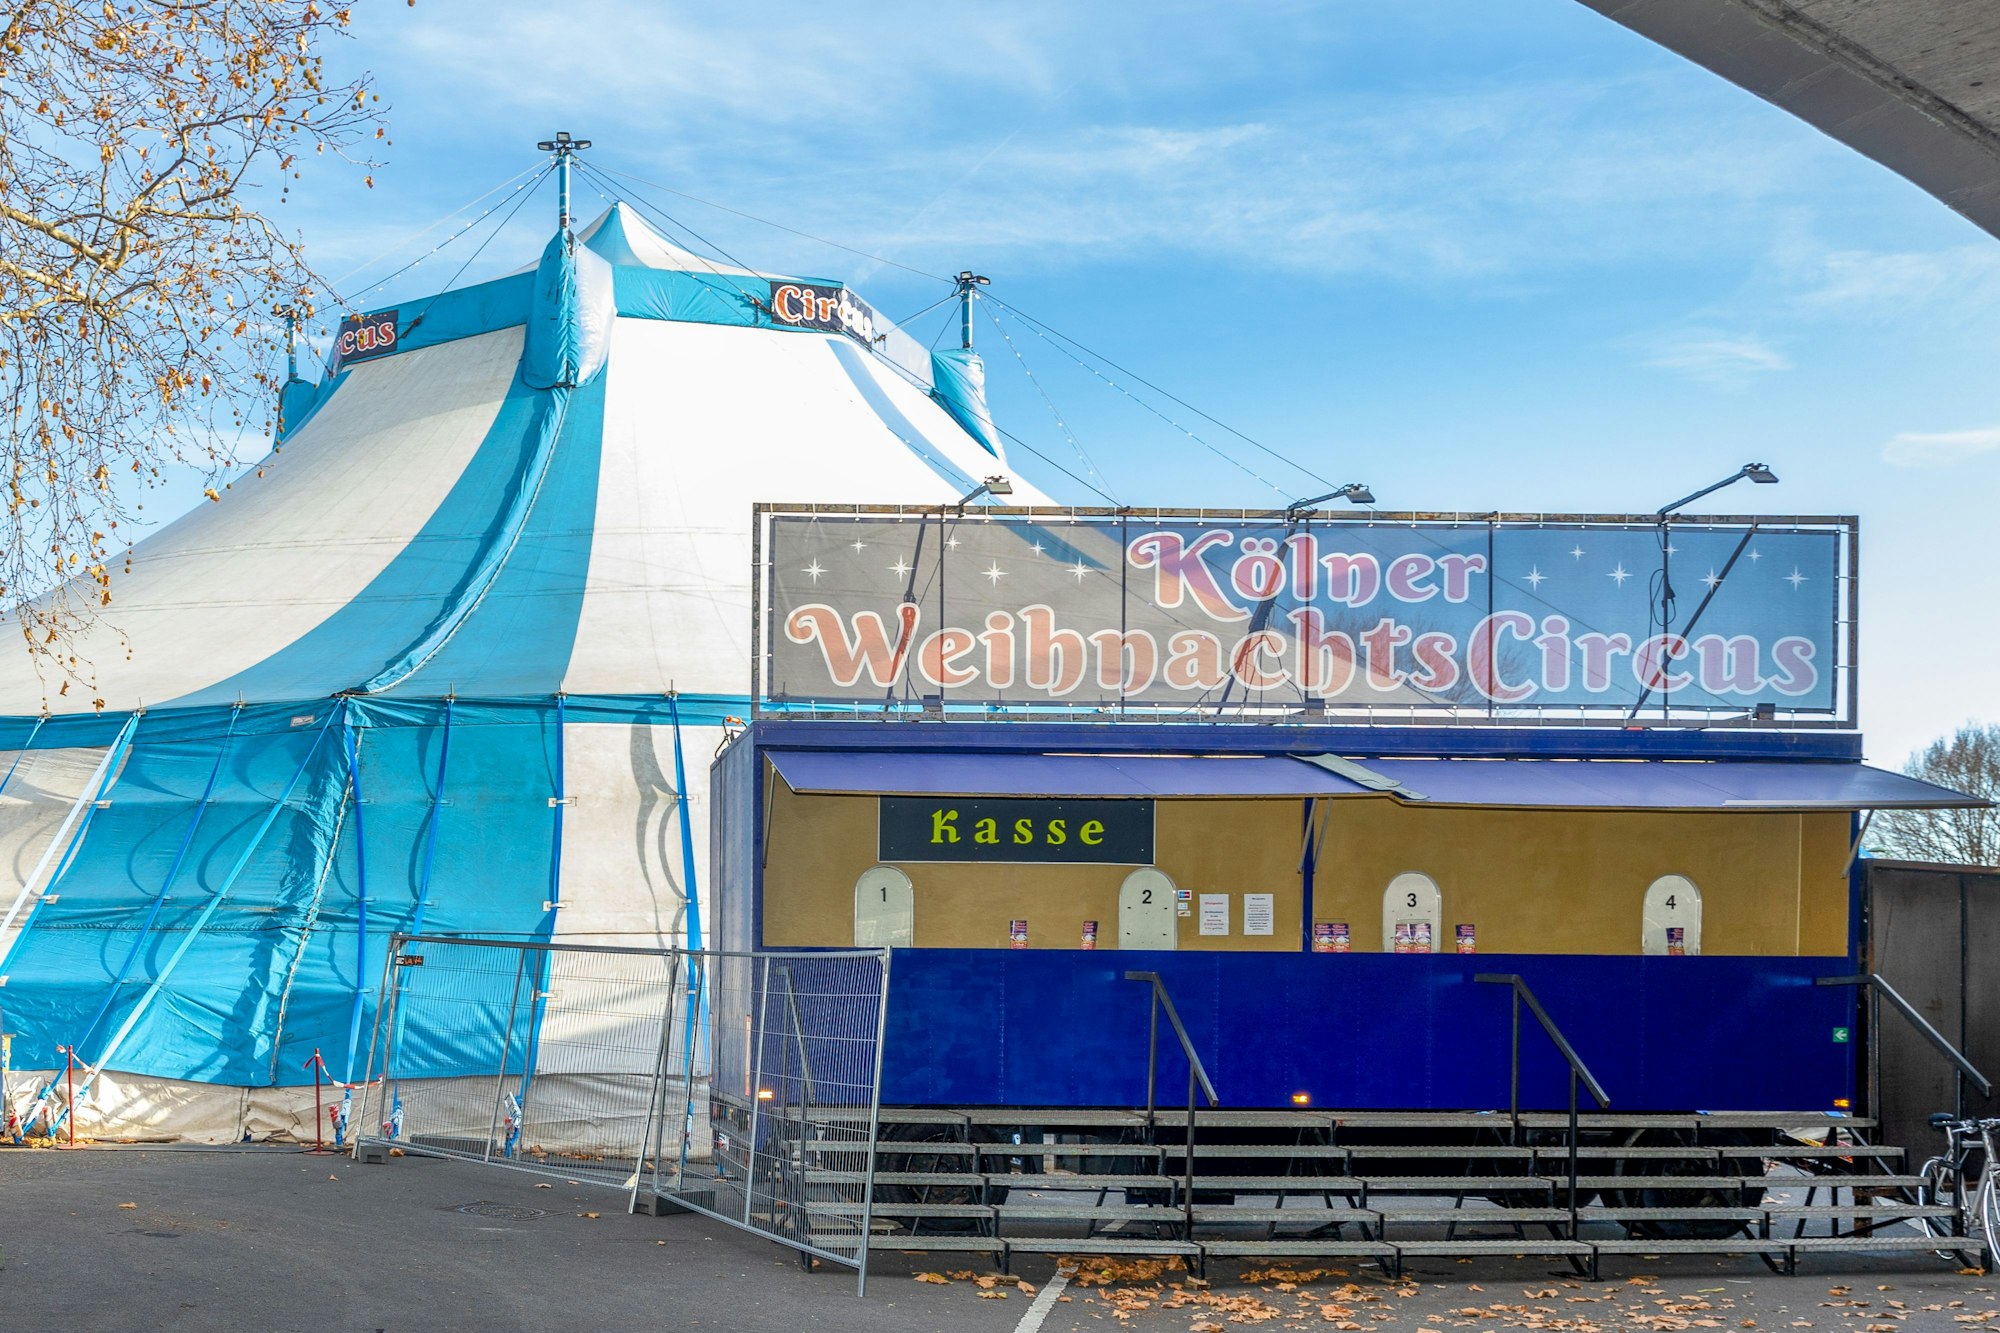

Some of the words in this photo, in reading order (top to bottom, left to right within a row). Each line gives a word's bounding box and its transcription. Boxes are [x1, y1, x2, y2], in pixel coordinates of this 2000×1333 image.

[334, 322, 396, 360] cus
[1127, 529, 1488, 622] Kölner
[784, 603, 1819, 702] WeihnachtsCircus
[930, 809, 1105, 845] Kasse
[880, 887, 887, 902] 1
[1141, 889, 1153, 905] 2
[1407, 893, 1417, 908] 3
[1665, 895, 1677, 910] 4
